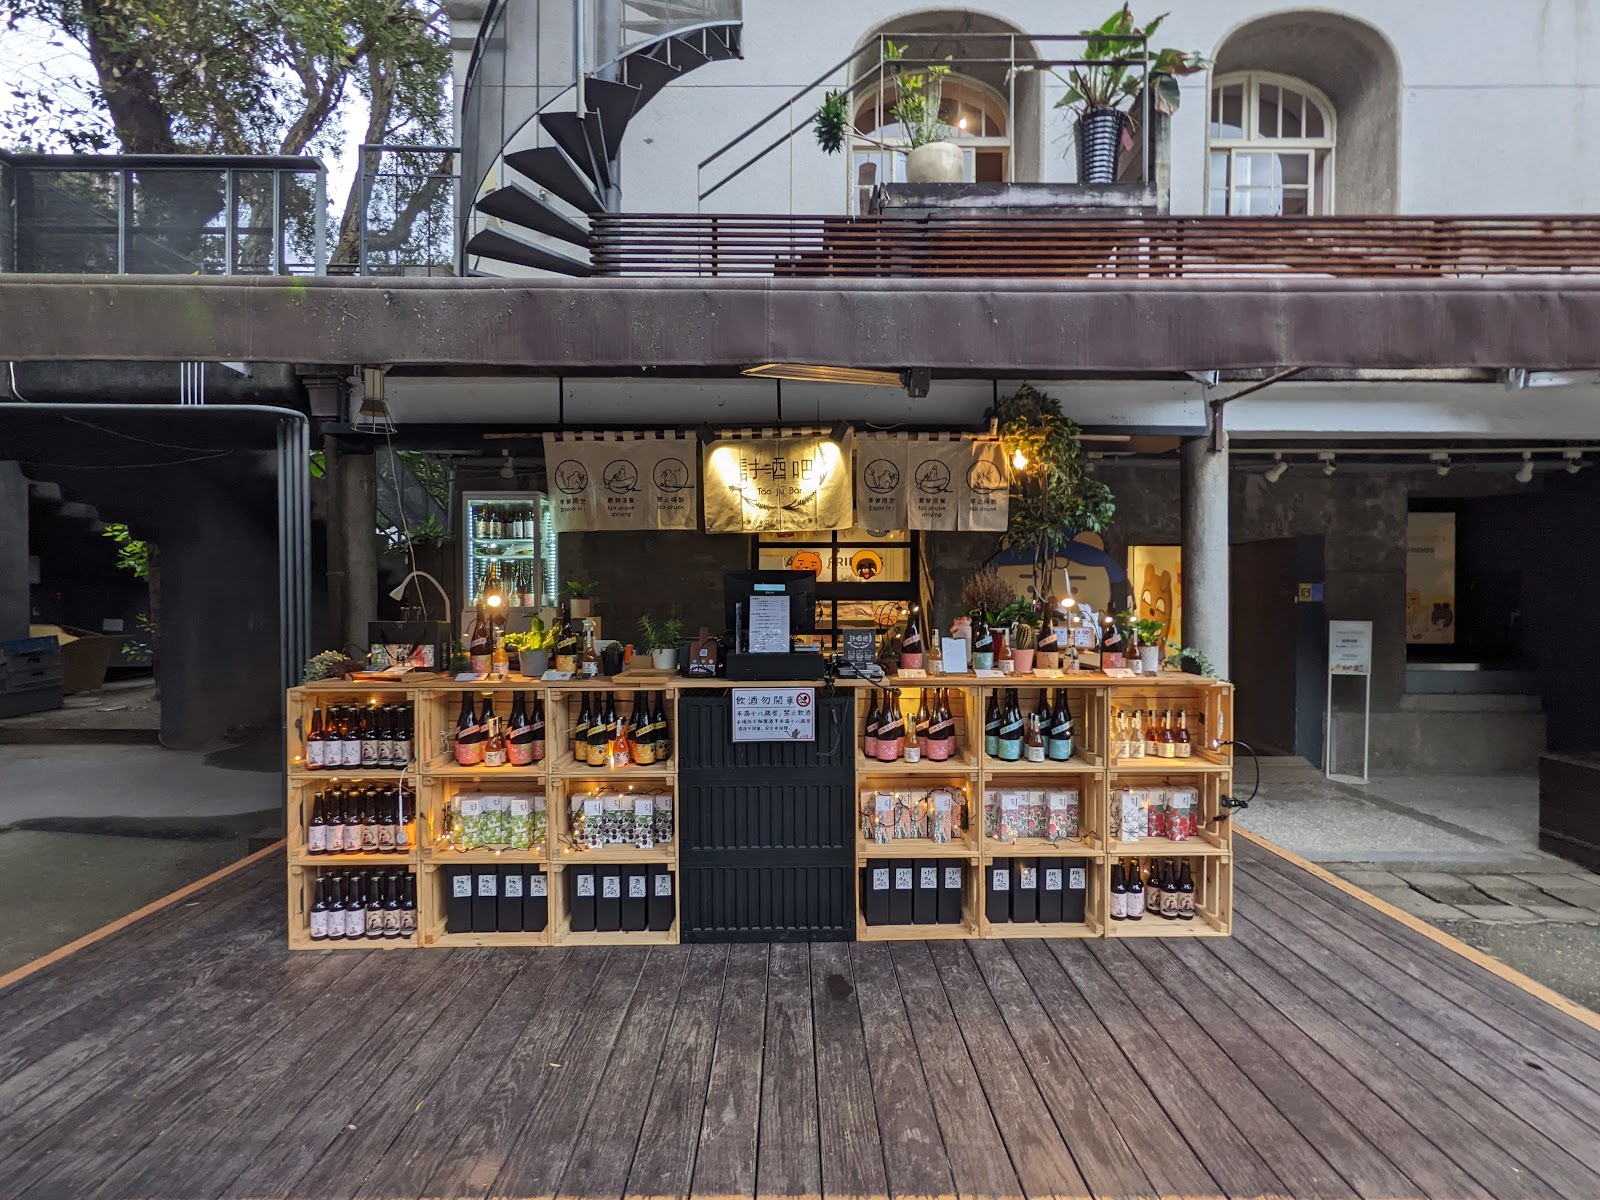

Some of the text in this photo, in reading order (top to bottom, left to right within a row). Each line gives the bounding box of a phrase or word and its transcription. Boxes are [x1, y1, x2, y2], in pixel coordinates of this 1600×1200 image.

[757, 487, 772, 496] Tao
[789, 486, 803, 495] Bar
[735, 695, 795, 706] 飲酒勿開車
